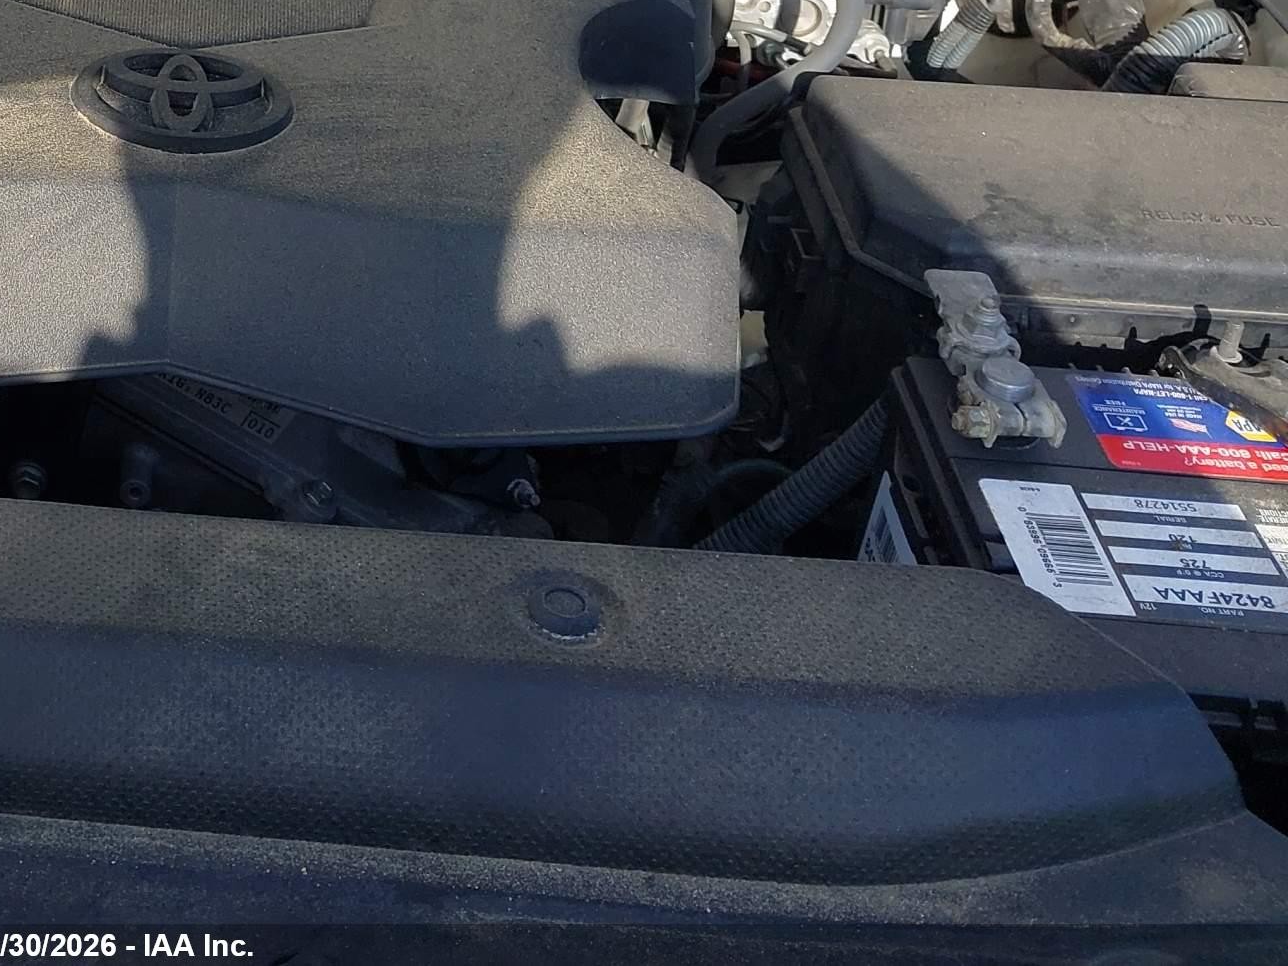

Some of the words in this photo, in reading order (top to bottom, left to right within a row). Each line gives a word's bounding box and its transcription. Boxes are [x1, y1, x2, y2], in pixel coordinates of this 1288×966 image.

[1141, 208, 1204, 224] RELAY
[1224, 214, 1281, 227] FUSE
[1141, 381, 1163, 390] NAPA
[247, 416, 276, 440] 010
[1123, 440, 1252, 459] 800-AAA-HELP
[1184, 455, 1246, 471] battery?
[1246, 461, 1258, 470] a
[1134, 499, 1197, 513] 5514278
[1153, 515, 1187, 523] SERIAL
[1180, 558, 1208, 569] 725
[1203, 571, 1225, 579] CCA
[1139, 602, 1157, 611] 12V
[1216, 608, 1245, 617] PART
